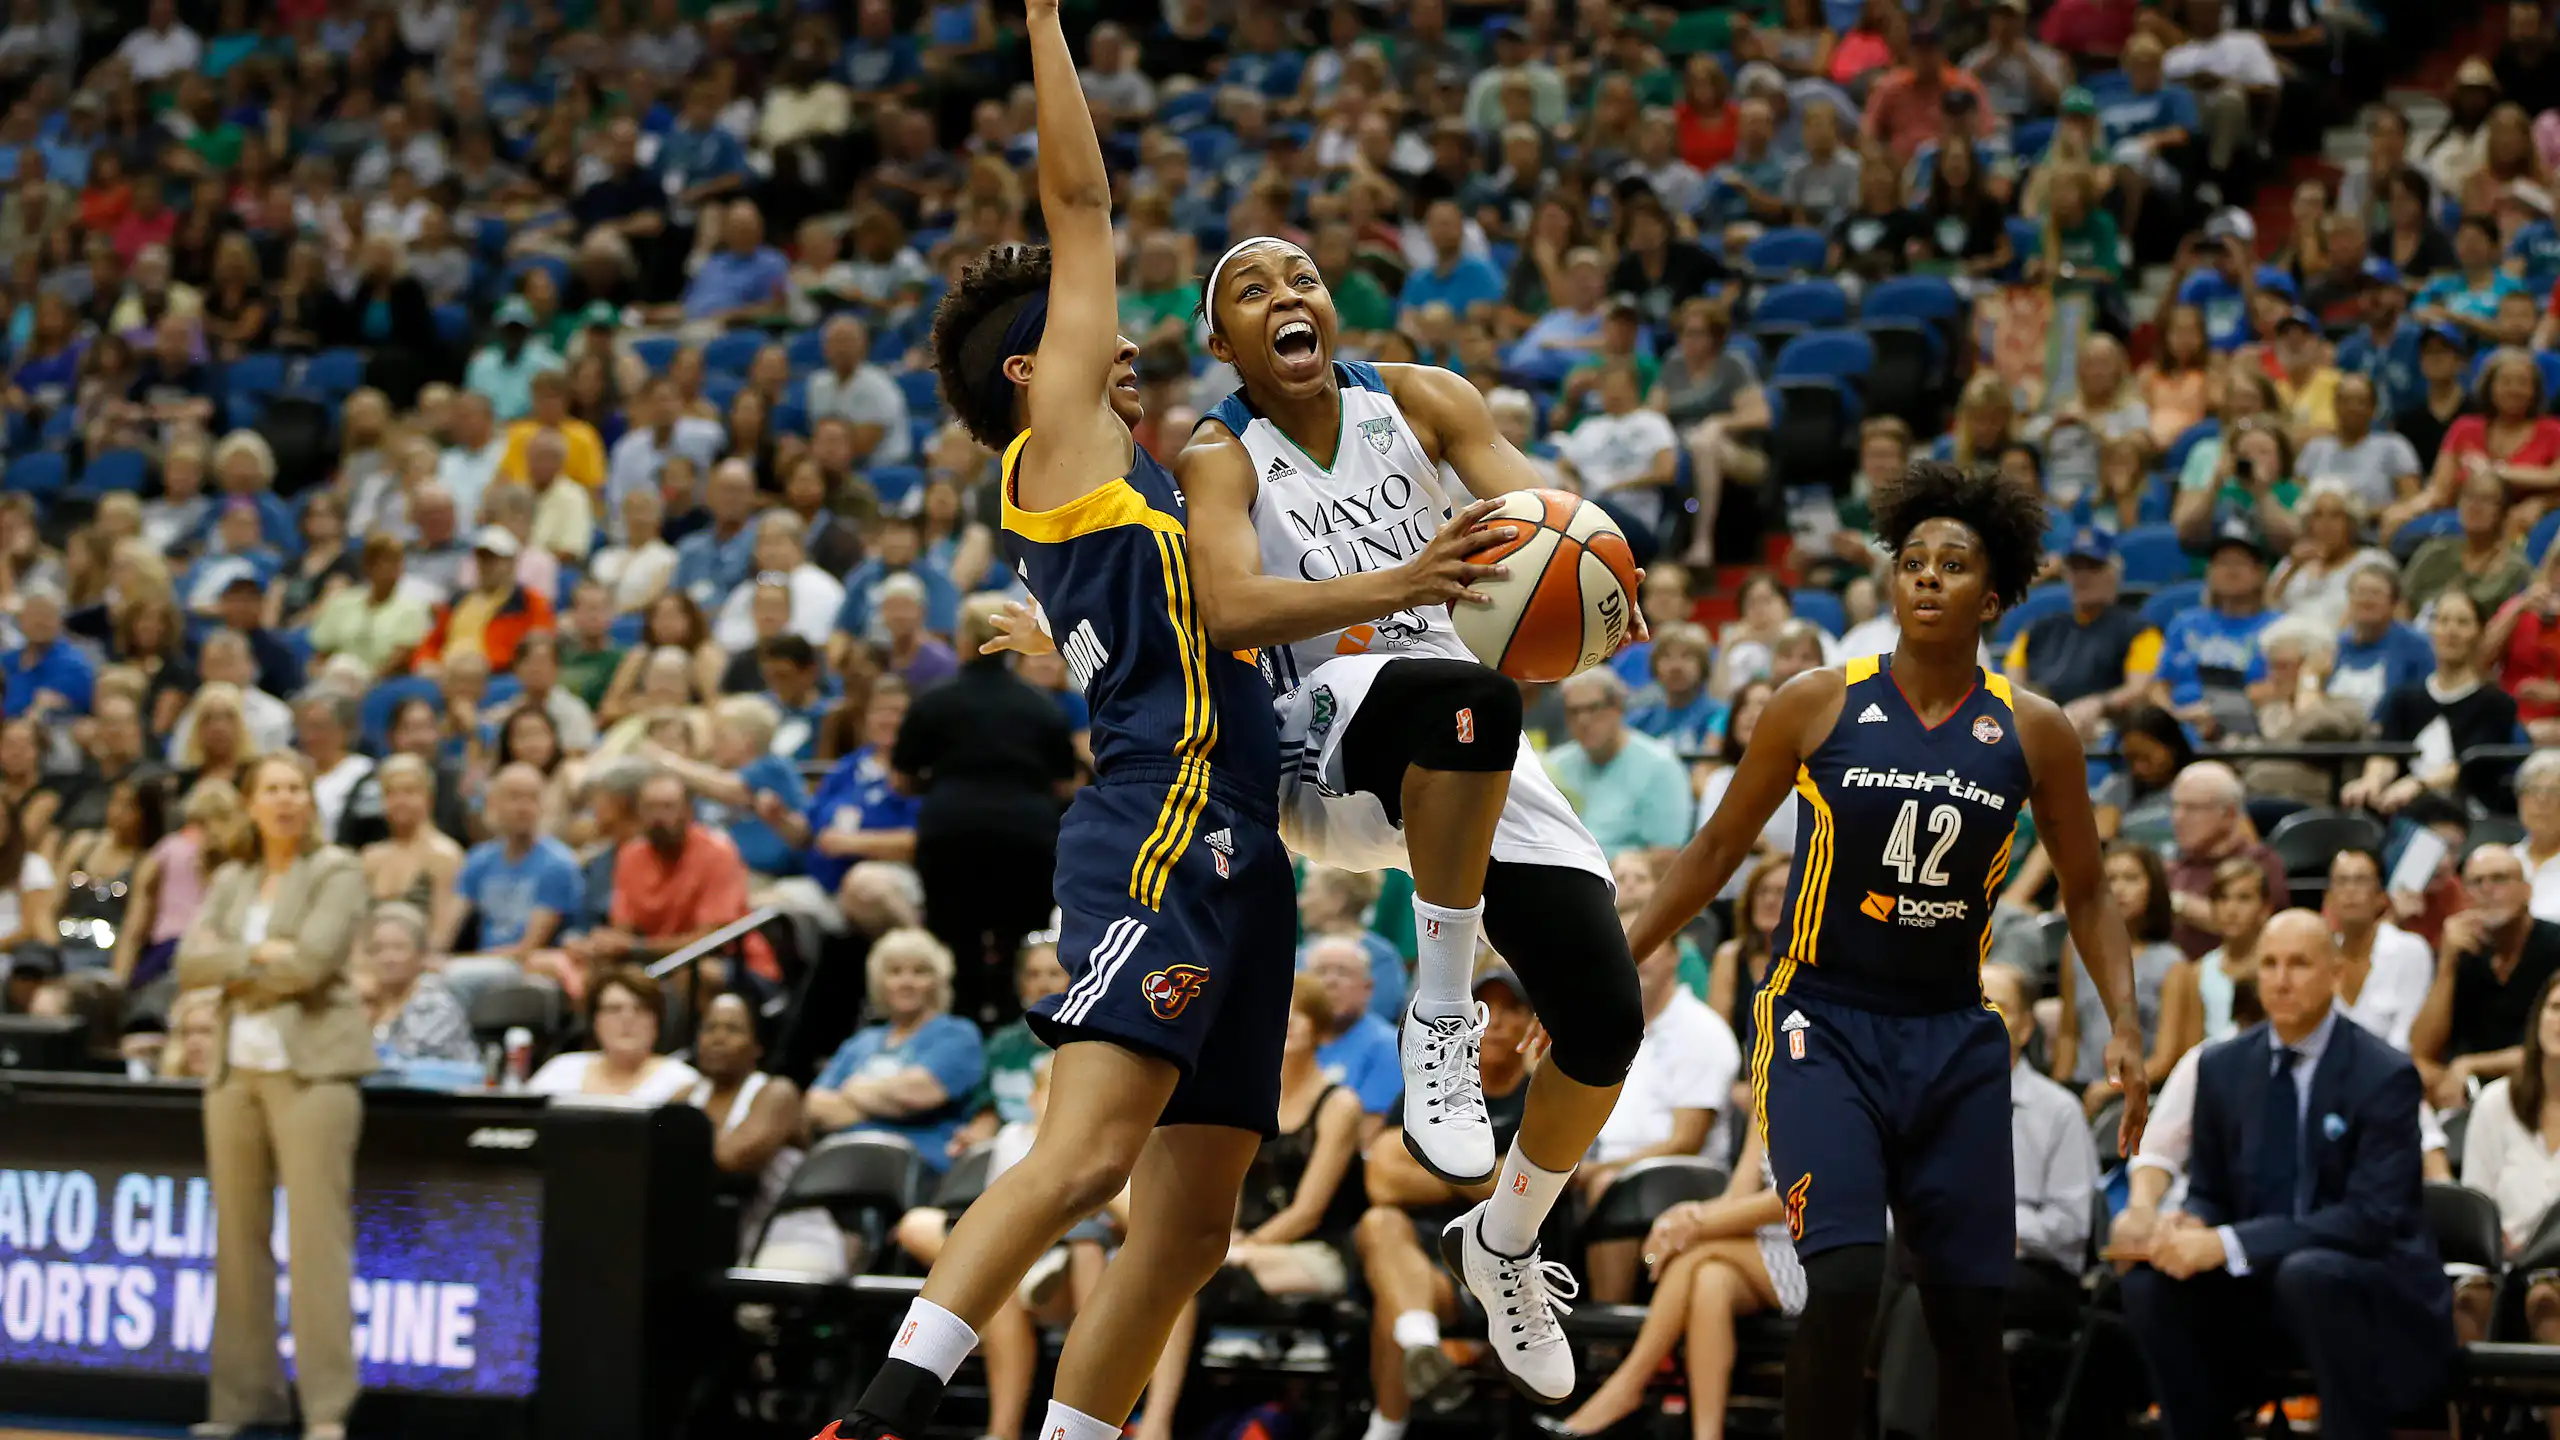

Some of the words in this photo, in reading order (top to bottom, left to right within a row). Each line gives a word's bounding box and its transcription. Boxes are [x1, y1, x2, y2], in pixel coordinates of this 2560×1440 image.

[1267, 468, 1298, 483] adidas
[1286, 473, 1412, 541] MAYO
[1299, 506, 1430, 582] CLINIC
[1841, 766, 1934, 792] Finish
[1882, 799, 1963, 887] 42
[1898, 895, 1969, 920] boost
[0, 1258, 157, 1351] ORTS
